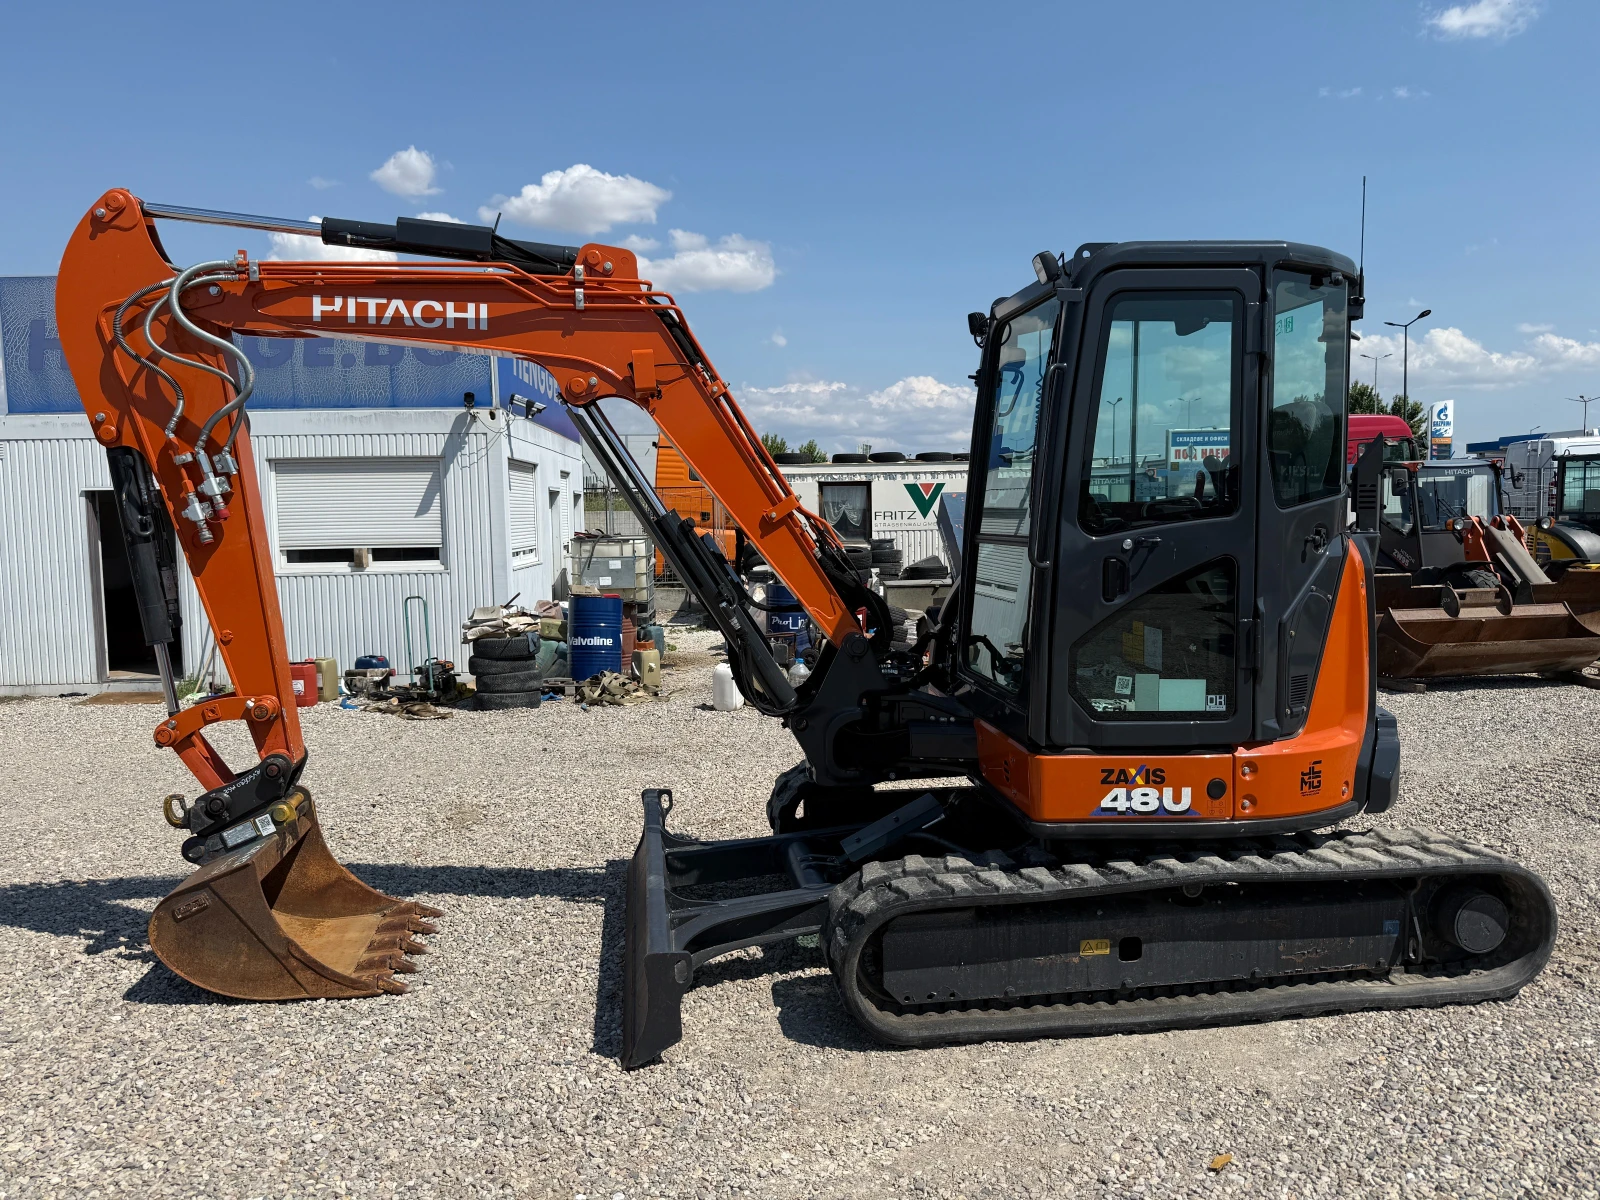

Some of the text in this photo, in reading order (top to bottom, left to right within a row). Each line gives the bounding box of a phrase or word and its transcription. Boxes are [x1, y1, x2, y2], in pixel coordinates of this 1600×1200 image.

[312, 294, 488, 331] HITACHI
[874, 510, 917, 521] FRITZ
[568, 636, 613, 646] Valvoline
[1101, 764, 1166, 785] ZAXIS
[1101, 787, 1192, 815] 48U
